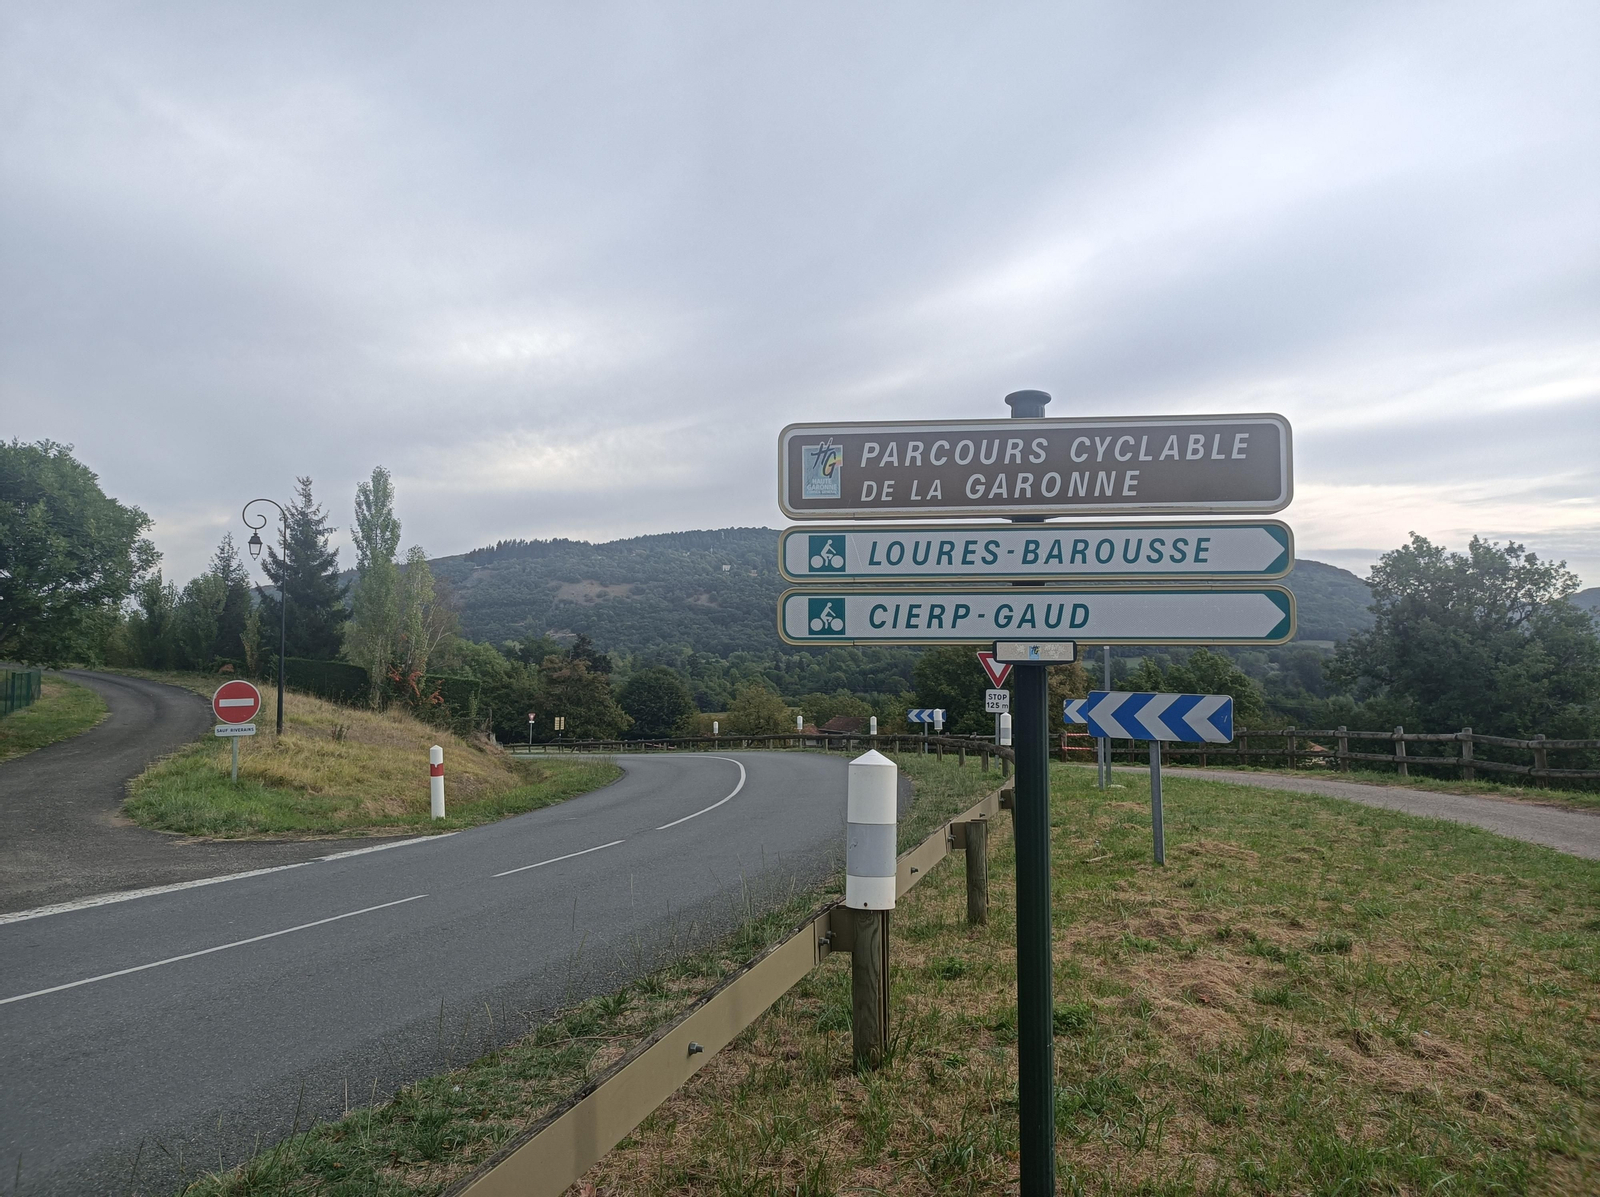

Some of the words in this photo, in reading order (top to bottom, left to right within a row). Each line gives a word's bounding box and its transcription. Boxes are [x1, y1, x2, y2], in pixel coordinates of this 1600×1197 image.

[860, 437, 1048, 468] PARCOURS
[1070, 433, 1250, 462] CYCLABLE
[861, 480, 895, 502] DE
[910, 478, 944, 500] LA
[965, 470, 1141, 499] GARONNE
[868, 536, 1212, 566] LOURES-BAROUSSE
[868, 603, 1091, 631] CIERP-GAUD
